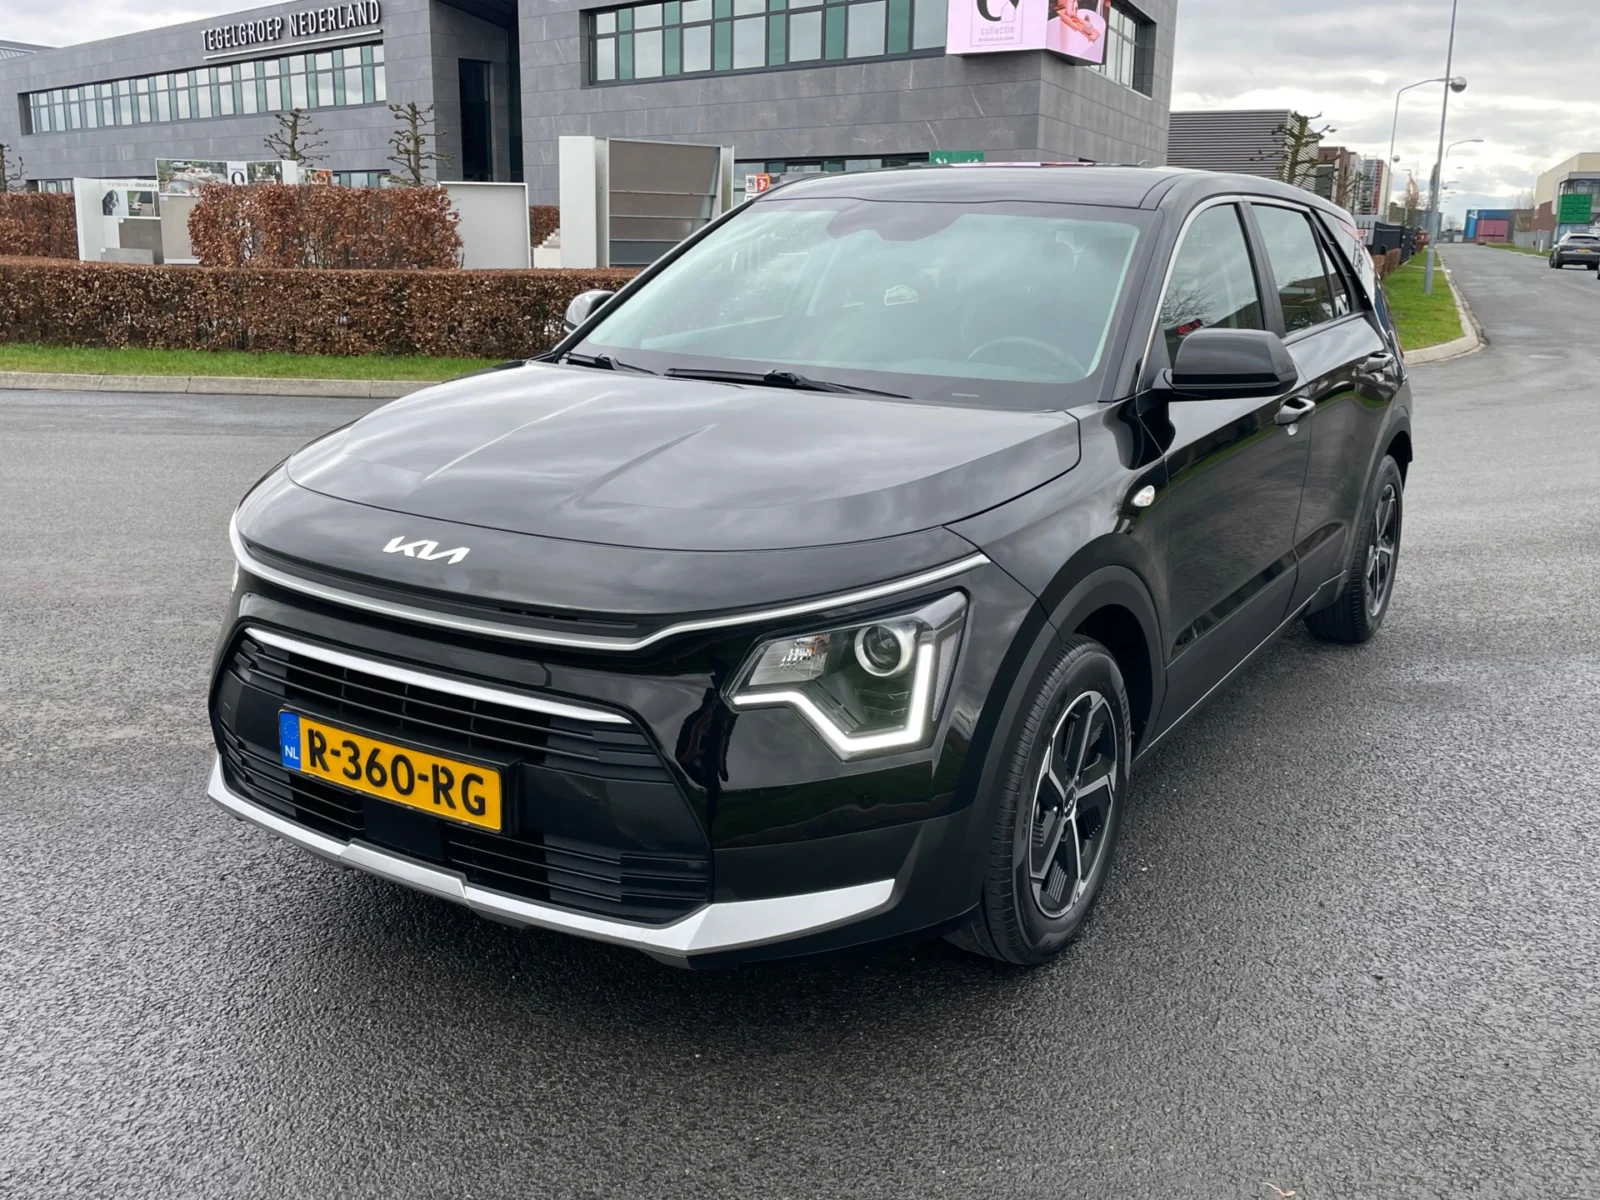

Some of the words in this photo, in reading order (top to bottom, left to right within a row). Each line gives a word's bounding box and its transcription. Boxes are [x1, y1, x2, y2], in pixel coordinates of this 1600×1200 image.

[201, 17, 282, 50] TEGELGROEP
[289, 0, 381, 37] NEDERLAND
[980, 25, 1015, 35] collectie
[382, 535, 470, 565] KIA
[284, 745, 299, 760] NL
[308, 728, 486, 816] R-360-RG
